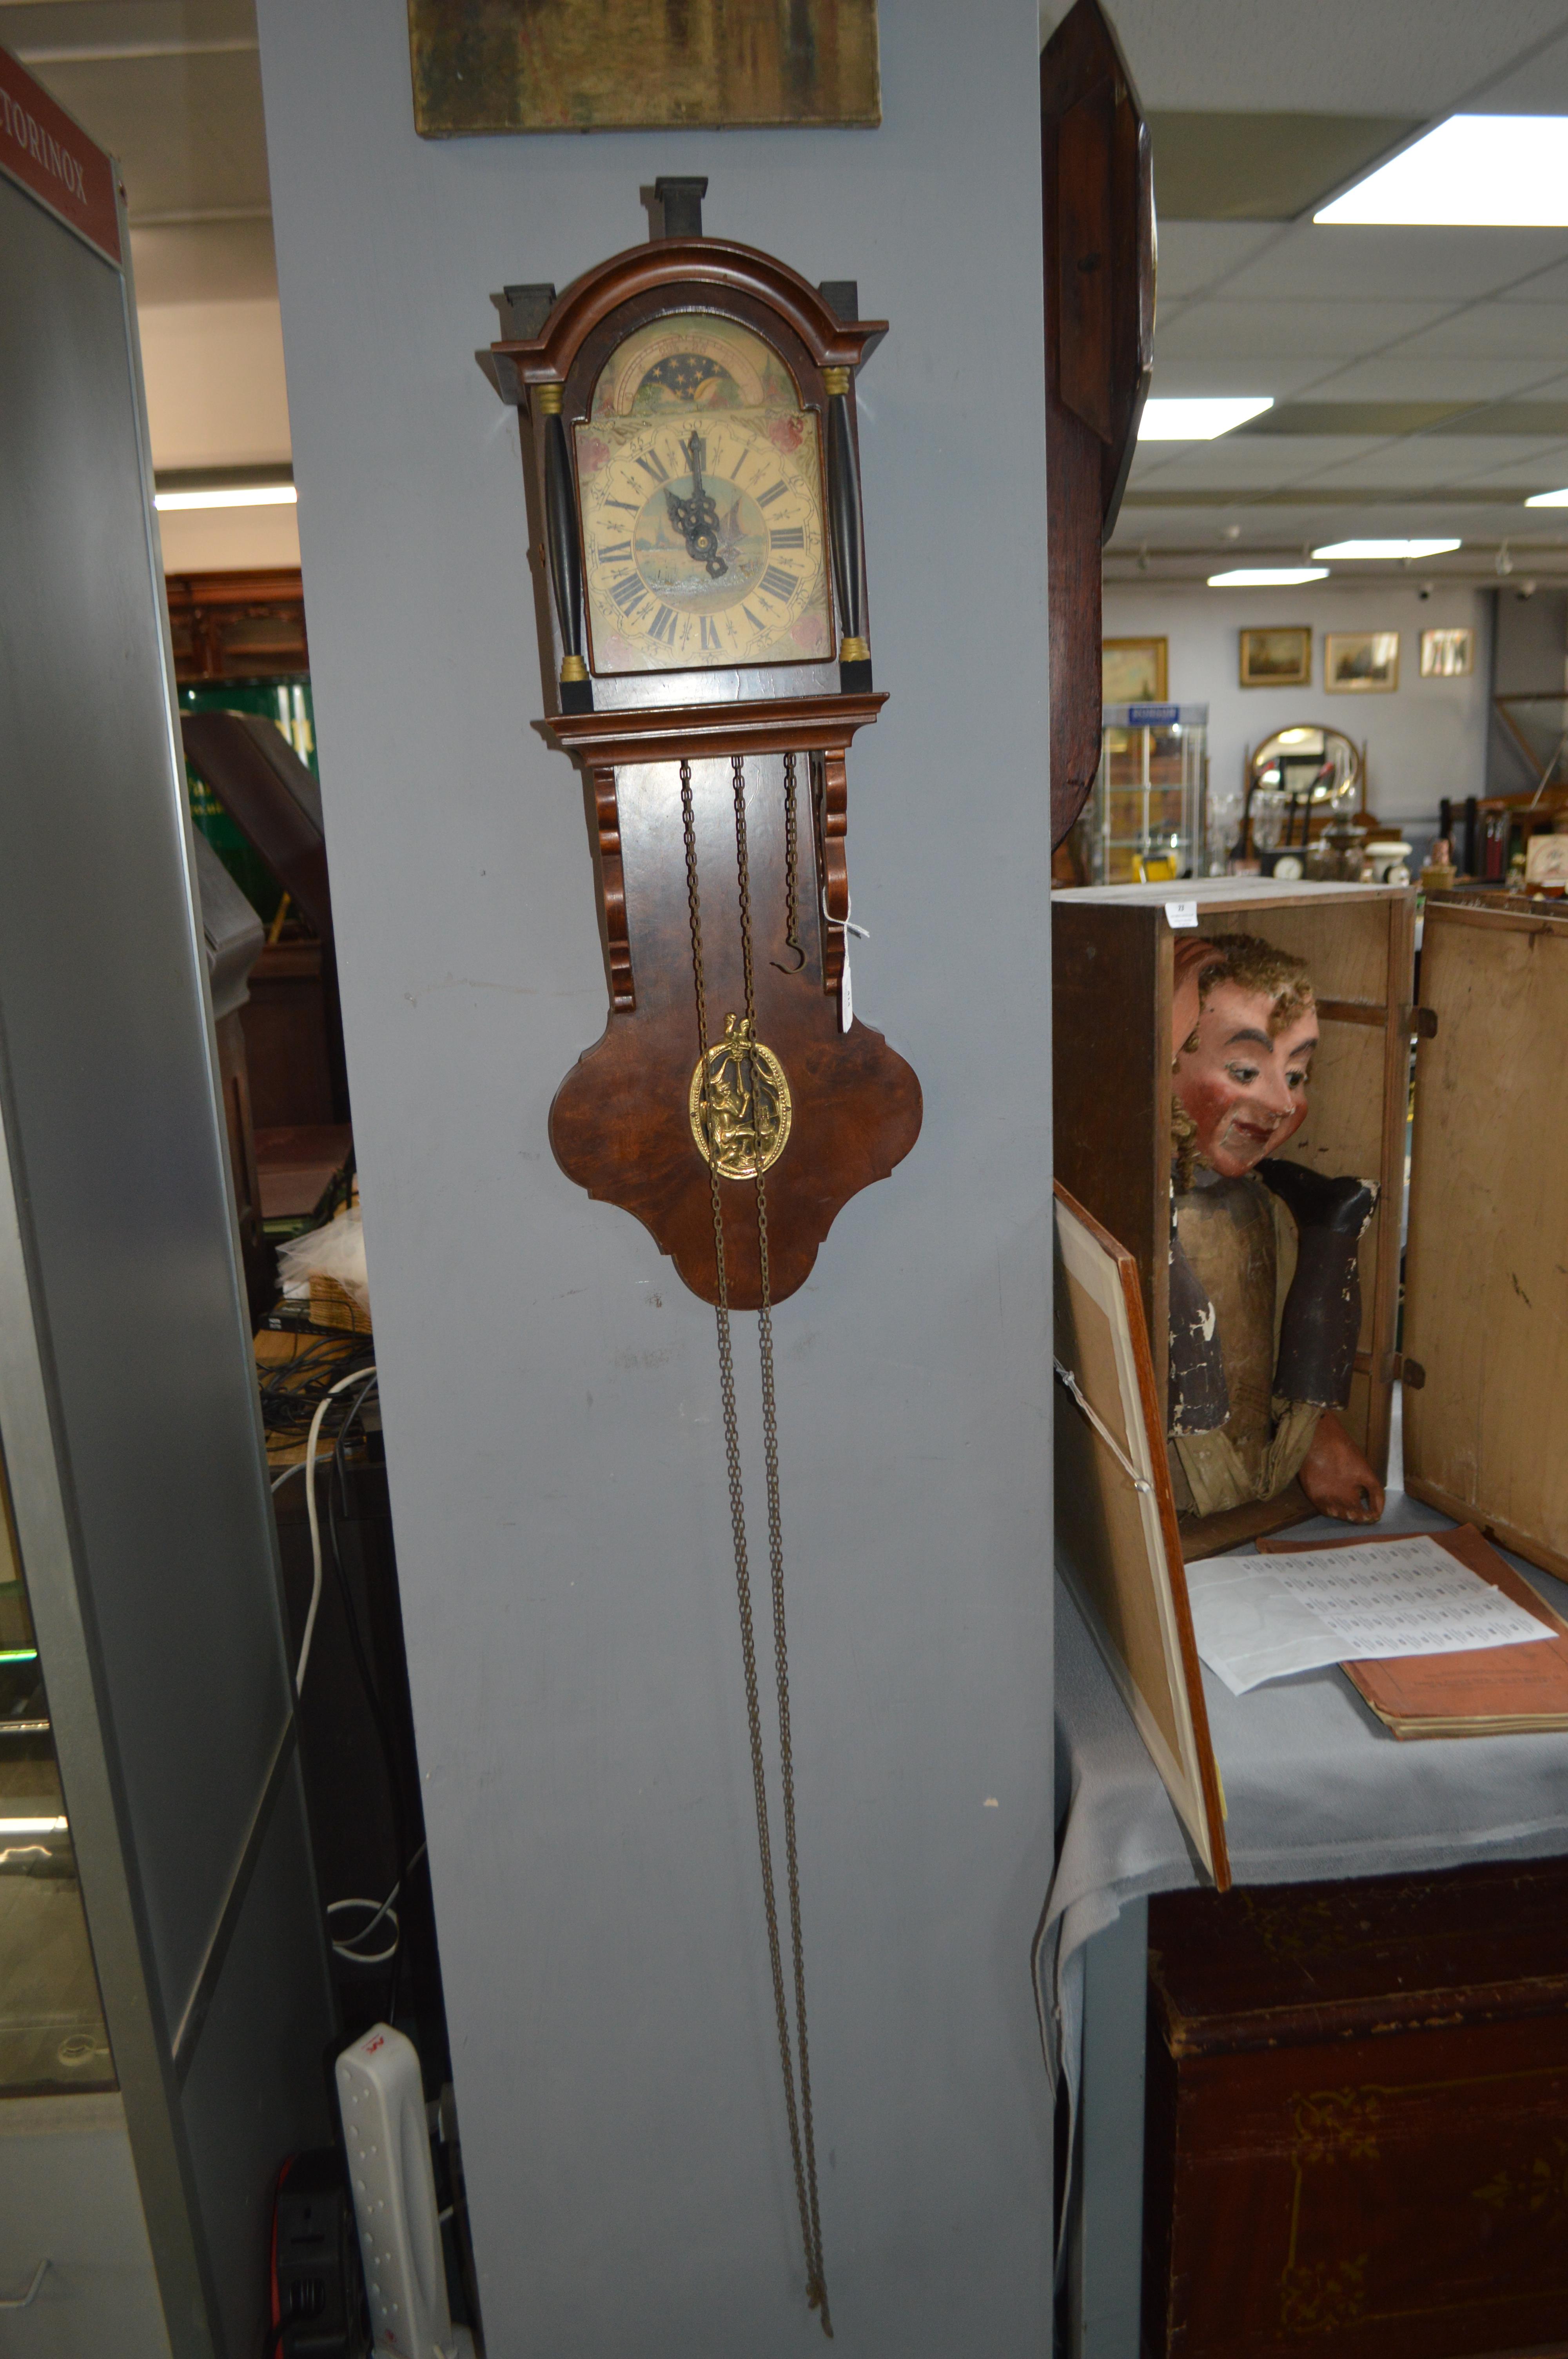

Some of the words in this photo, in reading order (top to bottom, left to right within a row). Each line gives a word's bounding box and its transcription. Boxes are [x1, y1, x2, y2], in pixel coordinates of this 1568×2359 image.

[0, 87, 87, 205] TORINOX
[683, 419, 702, 431] 60
[635, 449, 670, 489] XI
[679, 437, 707, 473] XI
[730, 448, 750, 480] I
[604, 492, 642, 520] X
[756, 479, 789, 510] II
[597, 539, 633, 565] IX
[769, 525, 804, 551] III
[608, 571, 650, 619] VIII
[757, 563, 800, 604] IIII
[645, 602, 681, 647] VII
[699, 615, 722, 651] VI
[740, 602, 767, 637] V
